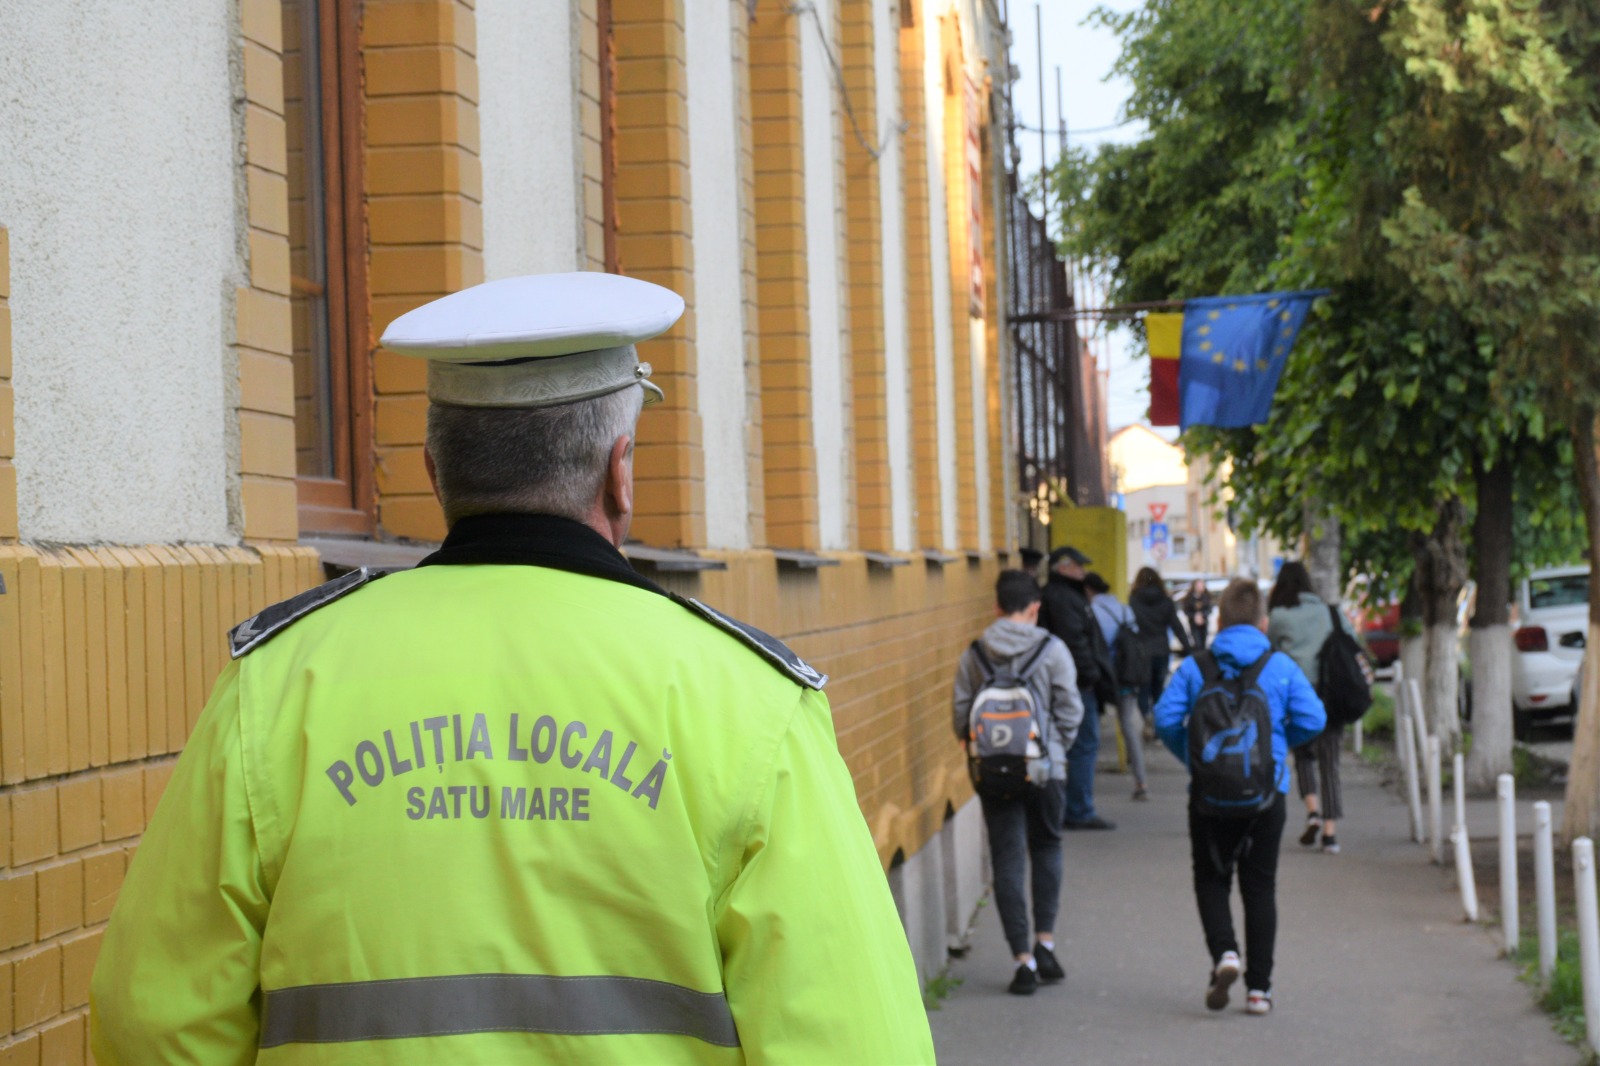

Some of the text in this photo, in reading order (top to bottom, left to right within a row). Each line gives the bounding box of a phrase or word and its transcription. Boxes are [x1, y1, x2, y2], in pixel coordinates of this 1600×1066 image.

[325, 713, 672, 810] POLIȚIA LOCALĂ
[406, 786, 590, 821] SATU MARE
